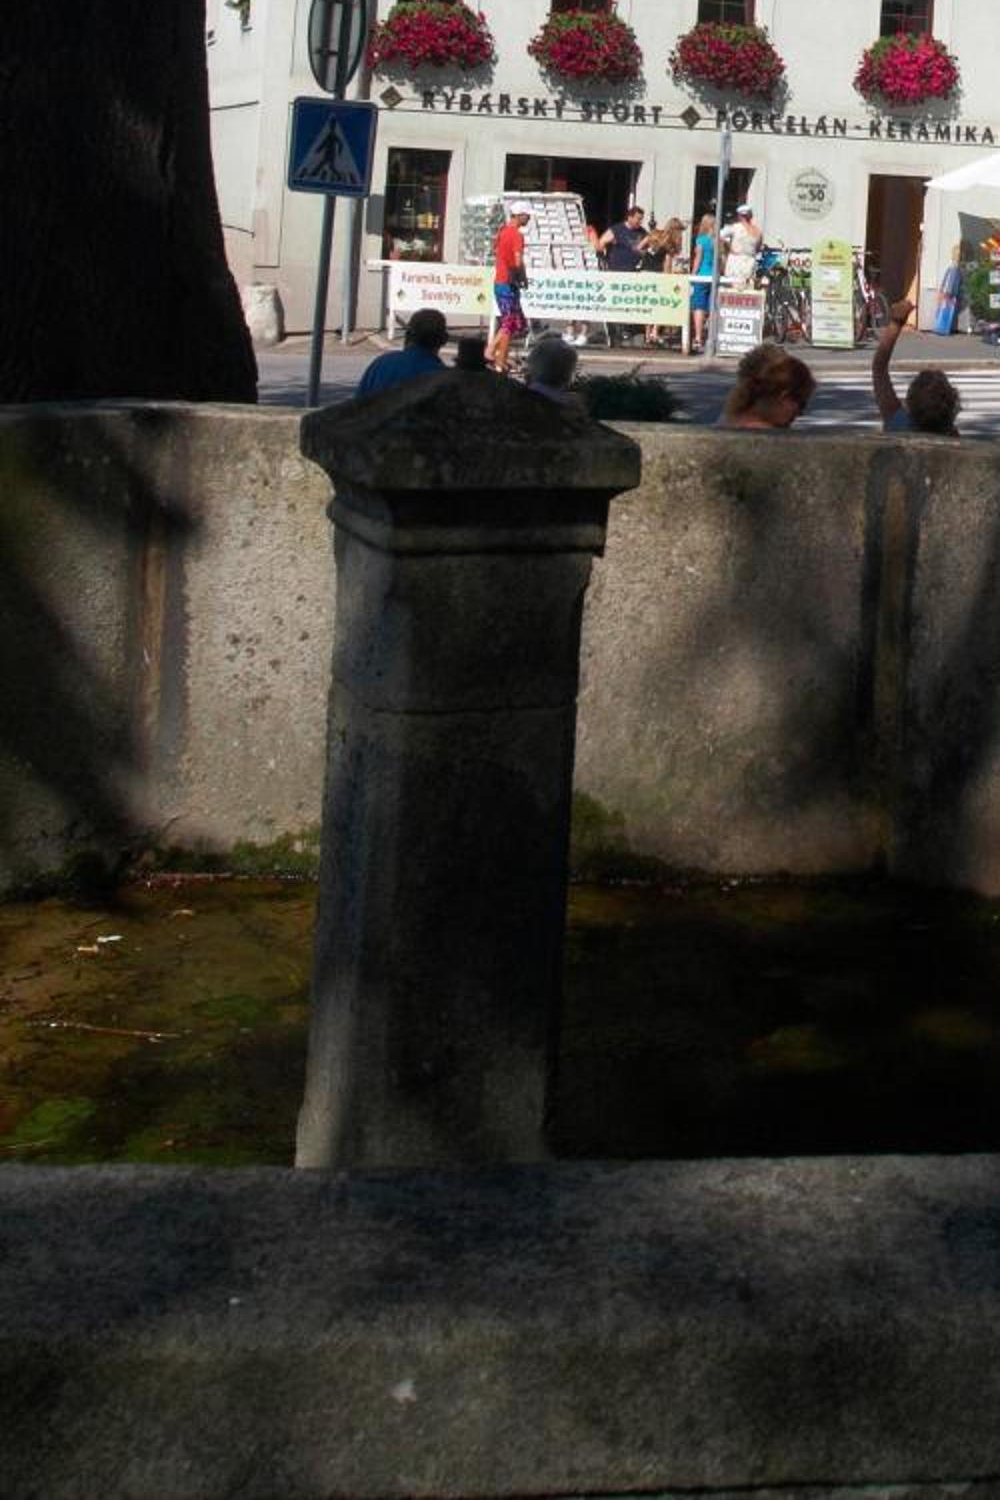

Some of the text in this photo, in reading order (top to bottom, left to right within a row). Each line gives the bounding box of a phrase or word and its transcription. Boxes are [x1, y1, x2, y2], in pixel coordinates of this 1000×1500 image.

[581, 100, 663, 124] SPORT
[715, 109, 848, 136] PORCELÁN
[869, 118, 995, 144] KERAMIKA
[610, 282, 657, 293] sport
[611, 294, 682, 309] potřeby
